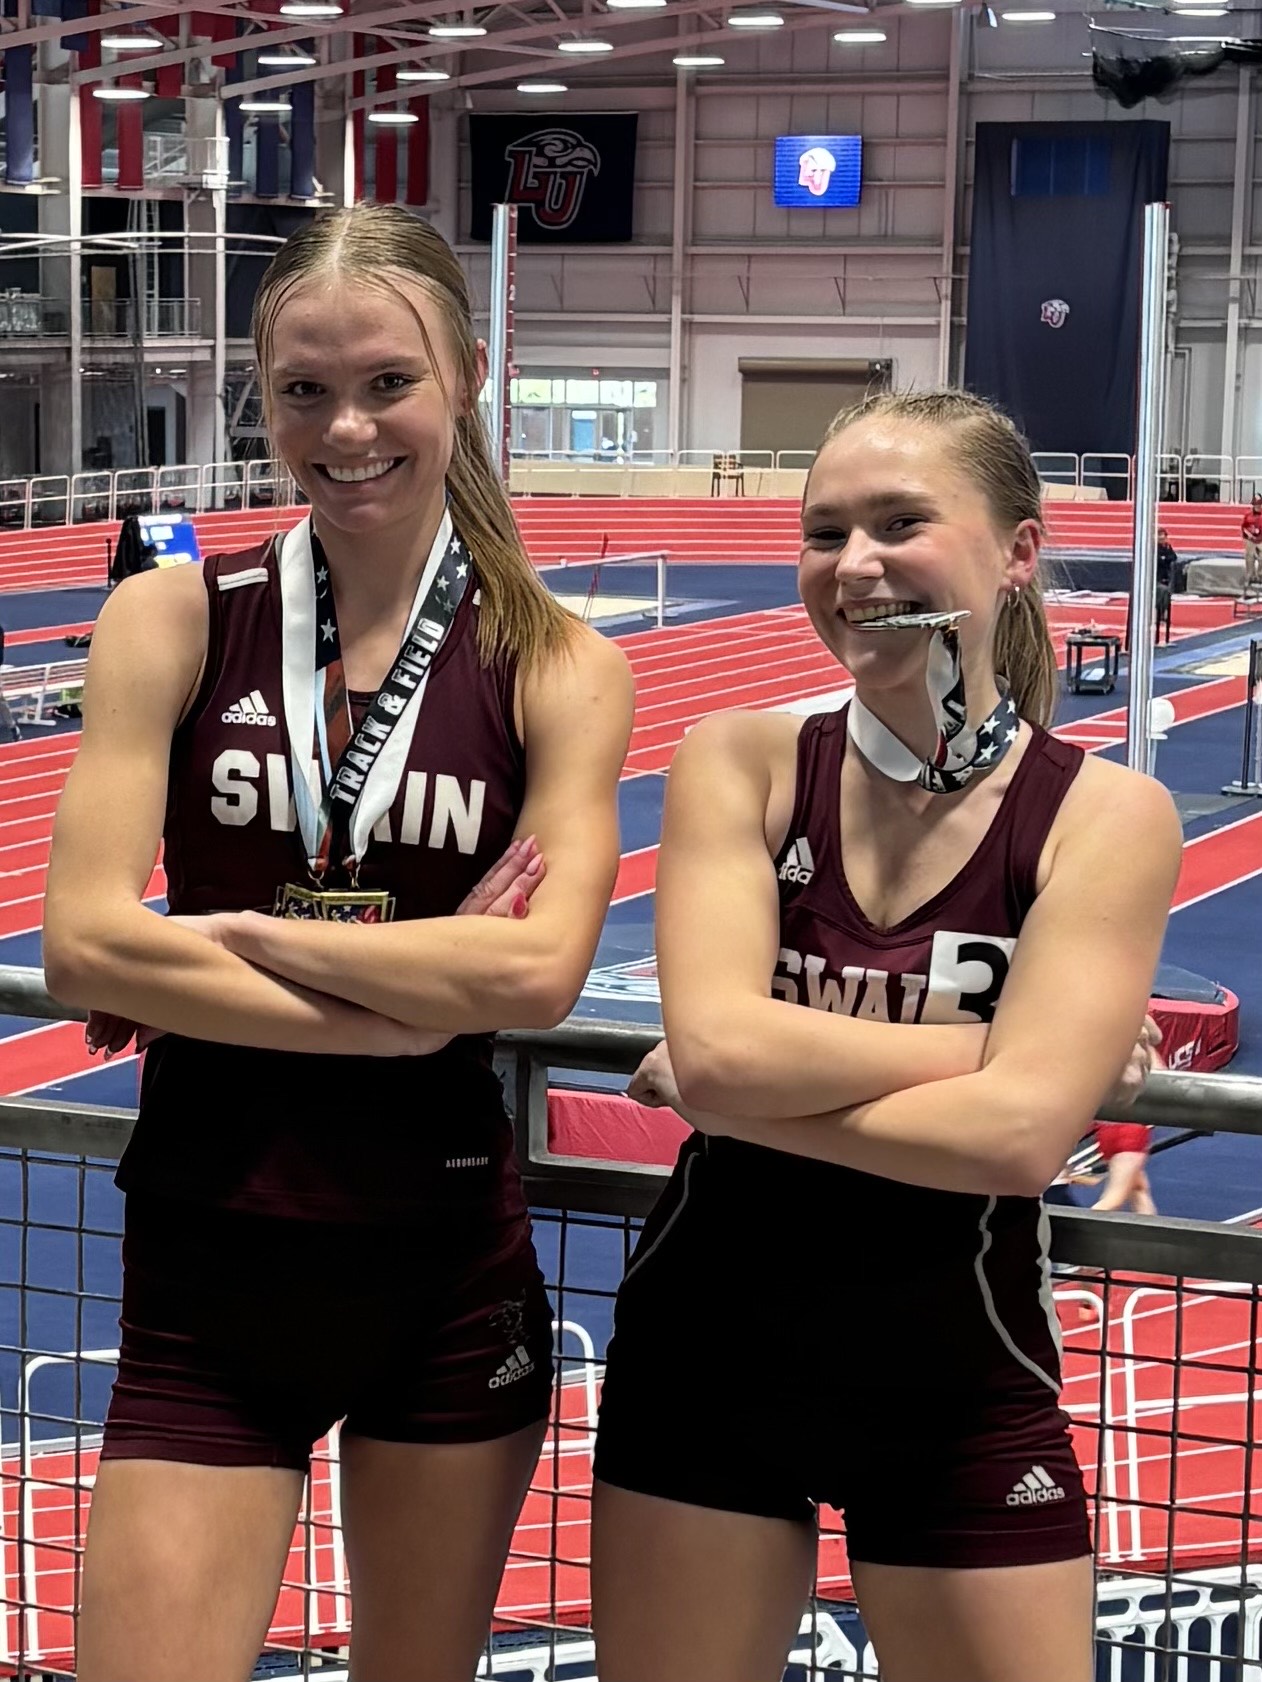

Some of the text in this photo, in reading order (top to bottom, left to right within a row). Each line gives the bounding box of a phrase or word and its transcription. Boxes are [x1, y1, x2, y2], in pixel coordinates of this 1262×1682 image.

[504, 145, 588, 230] LU
[221, 711, 276, 726] adidas
[330, 617, 445, 805] TRACK & FIELD
[211, 749, 486, 855] SIN
[771, 947, 927, 1024] SWAI
[488, 1362, 535, 1389] adidas
[1005, 1487, 1066, 1506] adidas
